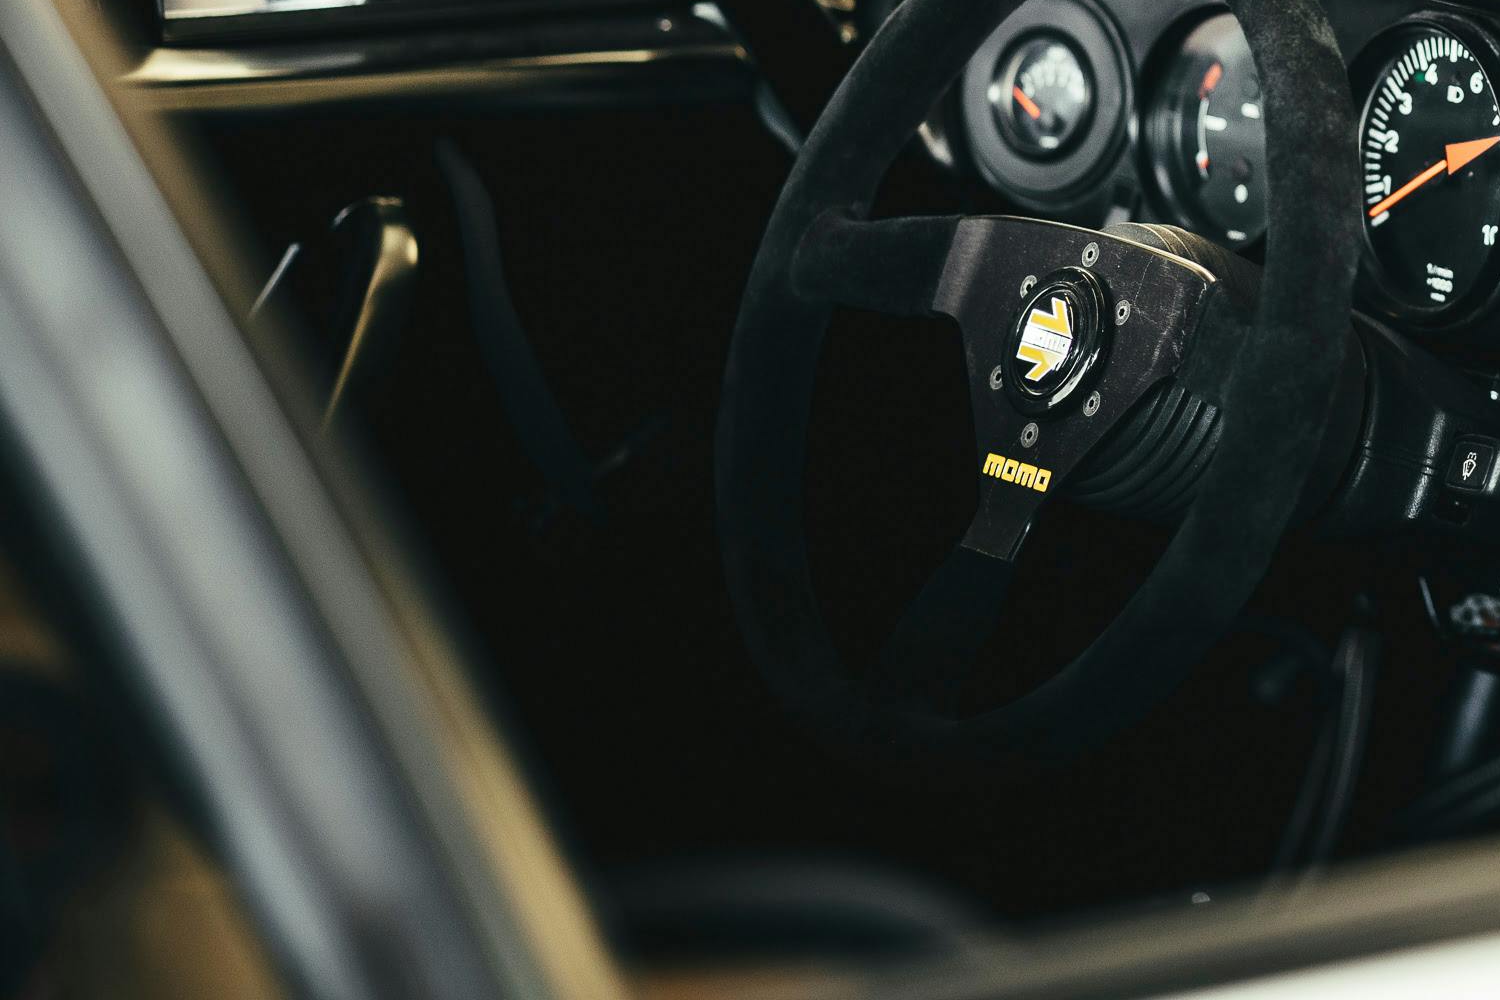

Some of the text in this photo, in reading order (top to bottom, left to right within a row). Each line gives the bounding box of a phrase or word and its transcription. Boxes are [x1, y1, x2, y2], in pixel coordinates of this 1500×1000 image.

[1469, 70, 1484, 94] 6
[1399, 92, 1413, 115] 3
[1384, 130, 1399, 154] 2
